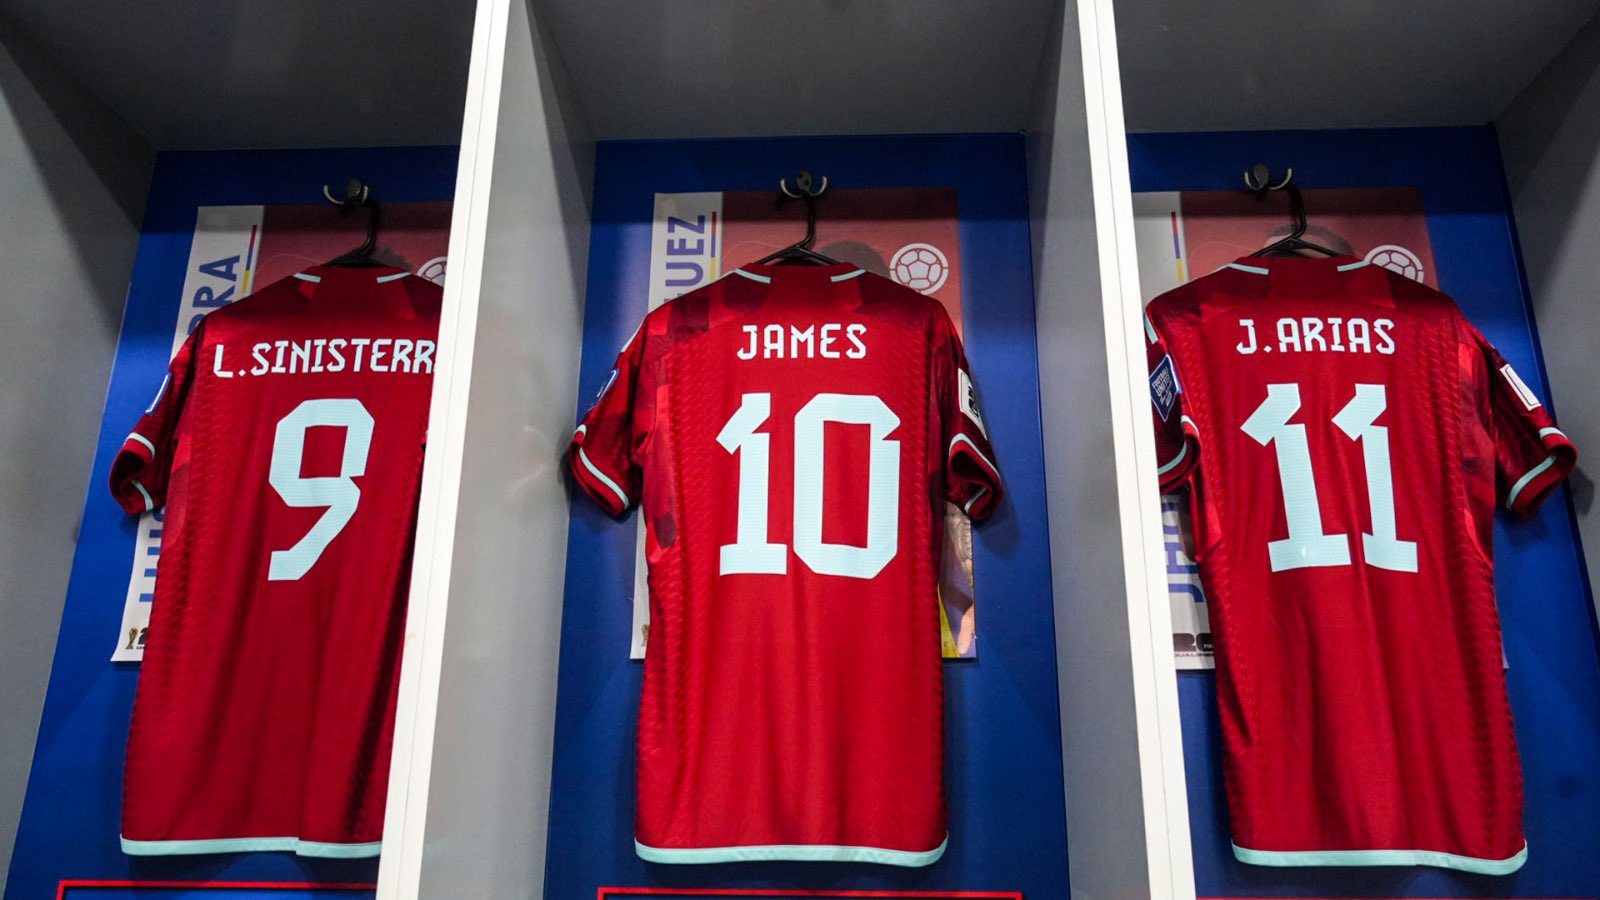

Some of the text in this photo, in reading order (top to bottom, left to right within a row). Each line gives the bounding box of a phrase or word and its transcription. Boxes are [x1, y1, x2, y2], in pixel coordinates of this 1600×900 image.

[663, 214, 705, 303] UEZ
[213, 338, 437, 378] L.SINISTERR
[736, 323, 867, 360] JAMES
[1236, 317, 1396, 355] J.ARIAS
[268, 398, 375, 581] 9
[715, 392, 901, 579] 10
[1239, 382, 1419, 573] 11
